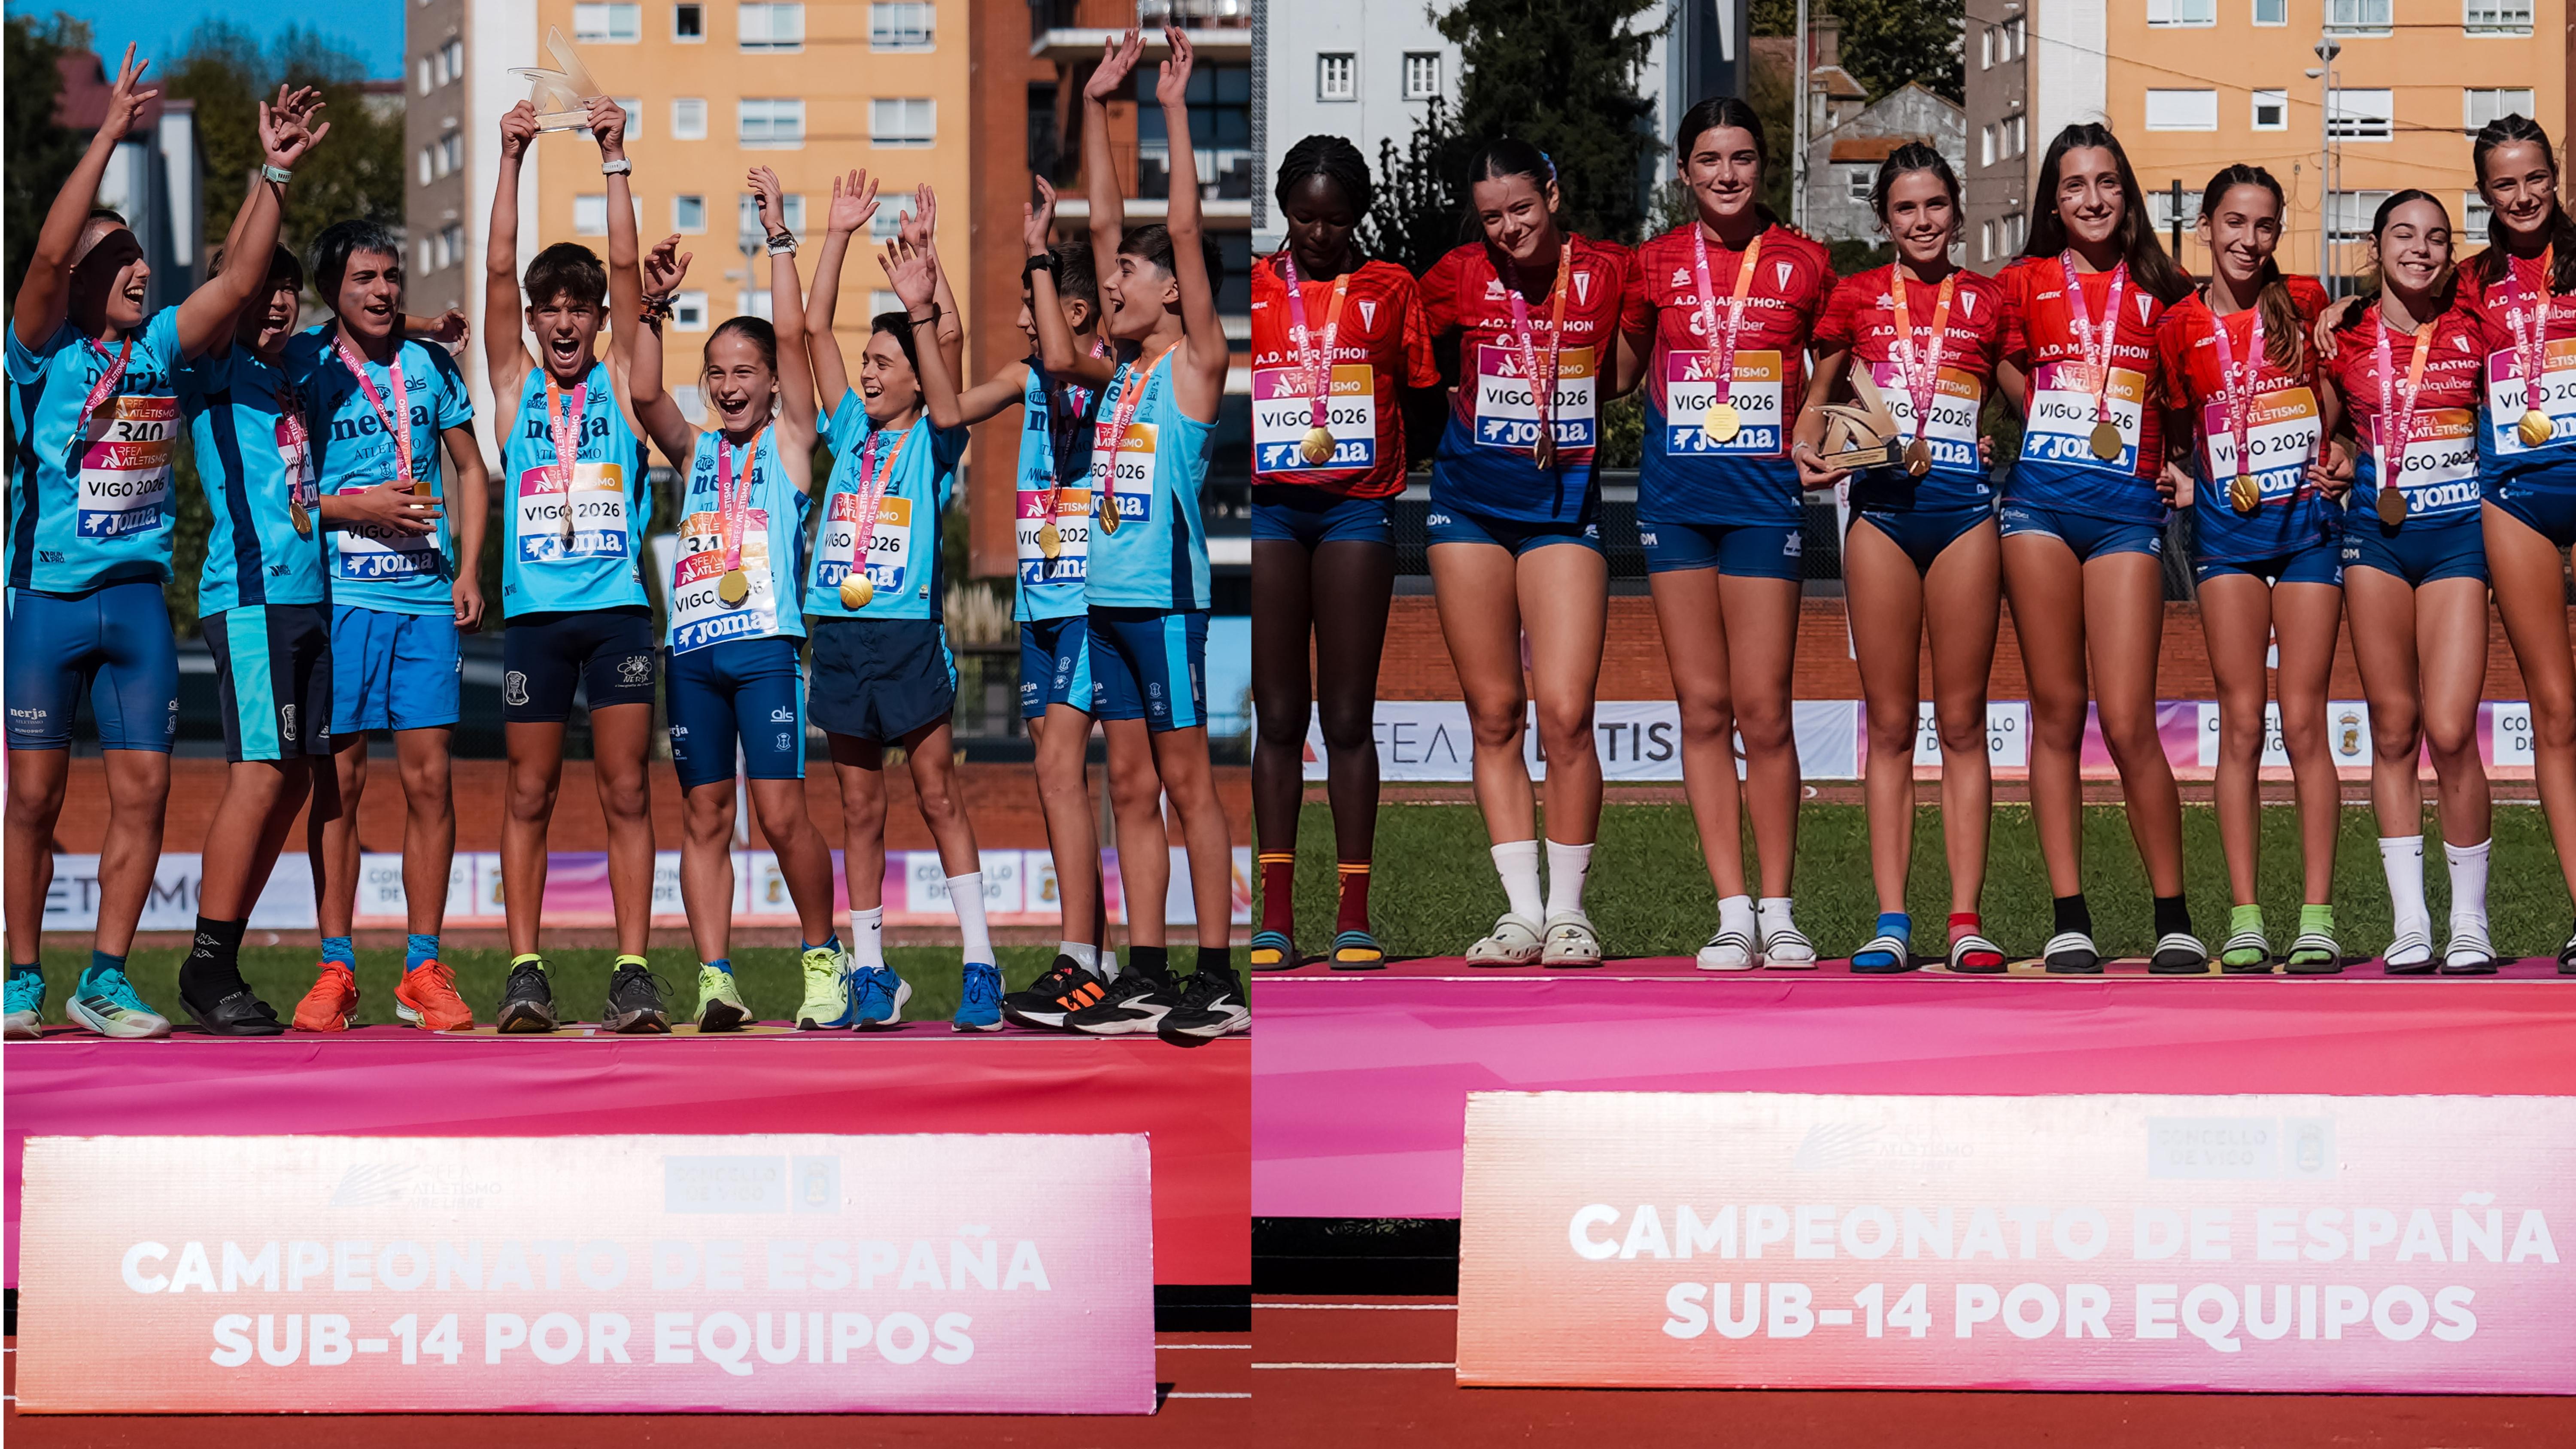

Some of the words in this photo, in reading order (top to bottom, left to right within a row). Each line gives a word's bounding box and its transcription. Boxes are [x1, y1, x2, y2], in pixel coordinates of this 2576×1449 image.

[1674, 295, 1699, 306] A.D.
[2040, 344, 2063, 357] A.D.
[1486, 387, 1535, 406] VIGO
[1730, 395, 1774, 410] 2026
[128, 409, 174, 418] ATLETISMO
[1261, 410, 1312, 428] VIGO
[1931, 407, 1972, 428] 2026
[2039, 403, 2081, 420] VIGO
[2087, 407, 2133, 430] 226
[2272, 430, 2316, 453] 2026
[118, 446, 143, 456] RFEA
[122, 453, 168, 466] ATLETISMO
[2405, 454, 2436, 471] GO
[1115, 465, 1145, 480] 026
[88, 481, 133, 497] VIGO
[136, 477, 164, 495] 2026
[579, 503, 620, 518] 2026
[824, 533, 851, 547] VIGO
[867, 536, 900, 553] 026
[1060, 528, 1088, 543] 202
[10, 708, 47, 720] nerja
[1568, 1203, 2109, 1261] CAMPEONATO
[2133, 1207, 2231, 1261] DE
[2256, 1191, 2560, 1264] ESPAÑA
[121, 1238, 630, 1294] CAMPEONATO
[651, 1239, 744, 1291] DE
[768, 1225, 1051, 1291] ESPAÑA
[1662, 1282, 1932, 1340] SUB-14
[1954, 1283, 2112, 1340] POR
[2134, 1284, 2478, 1353] EQUIPOS
[210, 1313, 464, 1368] SUB-14
[485, 1312, 632, 1365] POR
[654, 1311, 975, 1376] EQUIPOS
